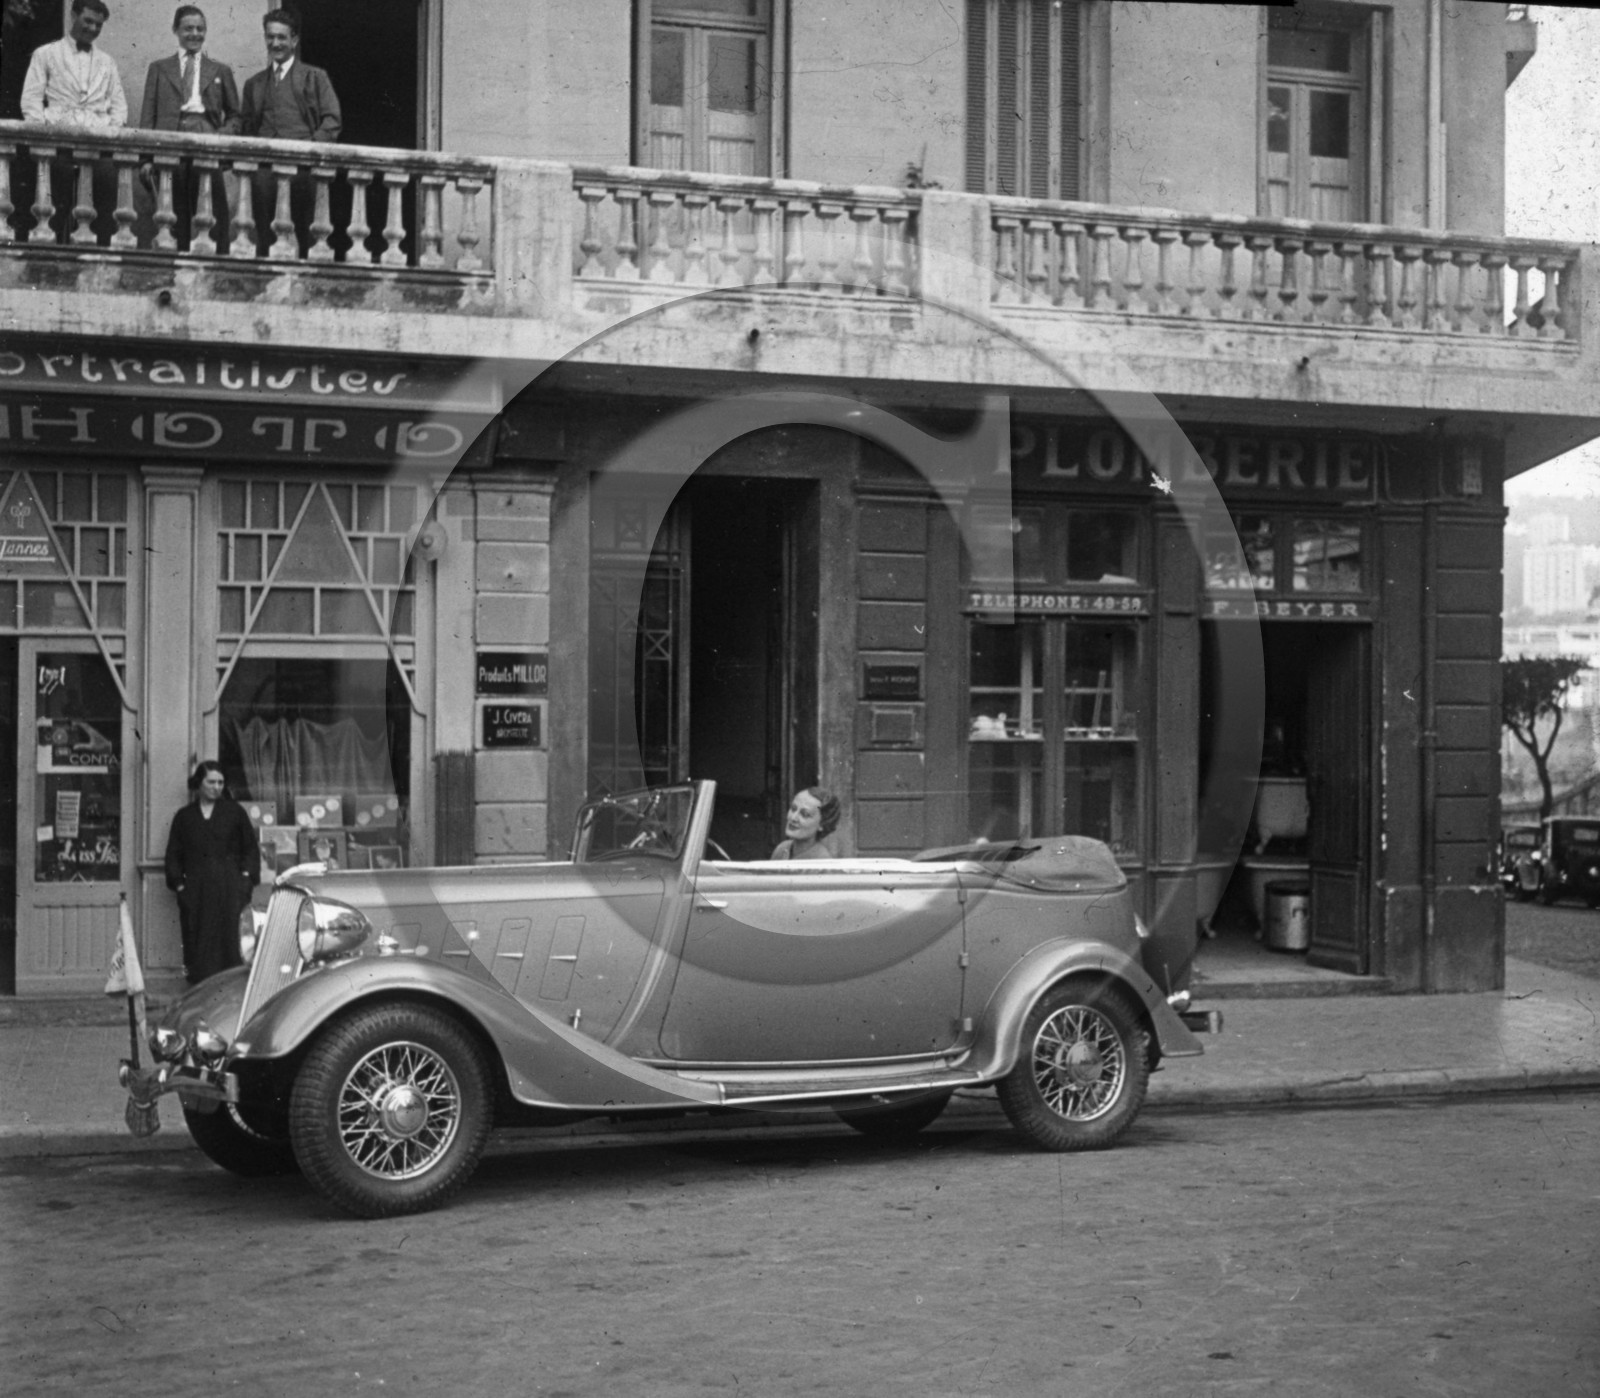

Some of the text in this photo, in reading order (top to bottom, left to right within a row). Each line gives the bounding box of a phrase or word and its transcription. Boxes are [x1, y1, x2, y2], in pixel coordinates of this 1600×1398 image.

[993, 425, 1370, 490] PLOMBERIE
[1254, 600, 1359, 617] BEYER
[512, 664, 547, 684] MILLOR
